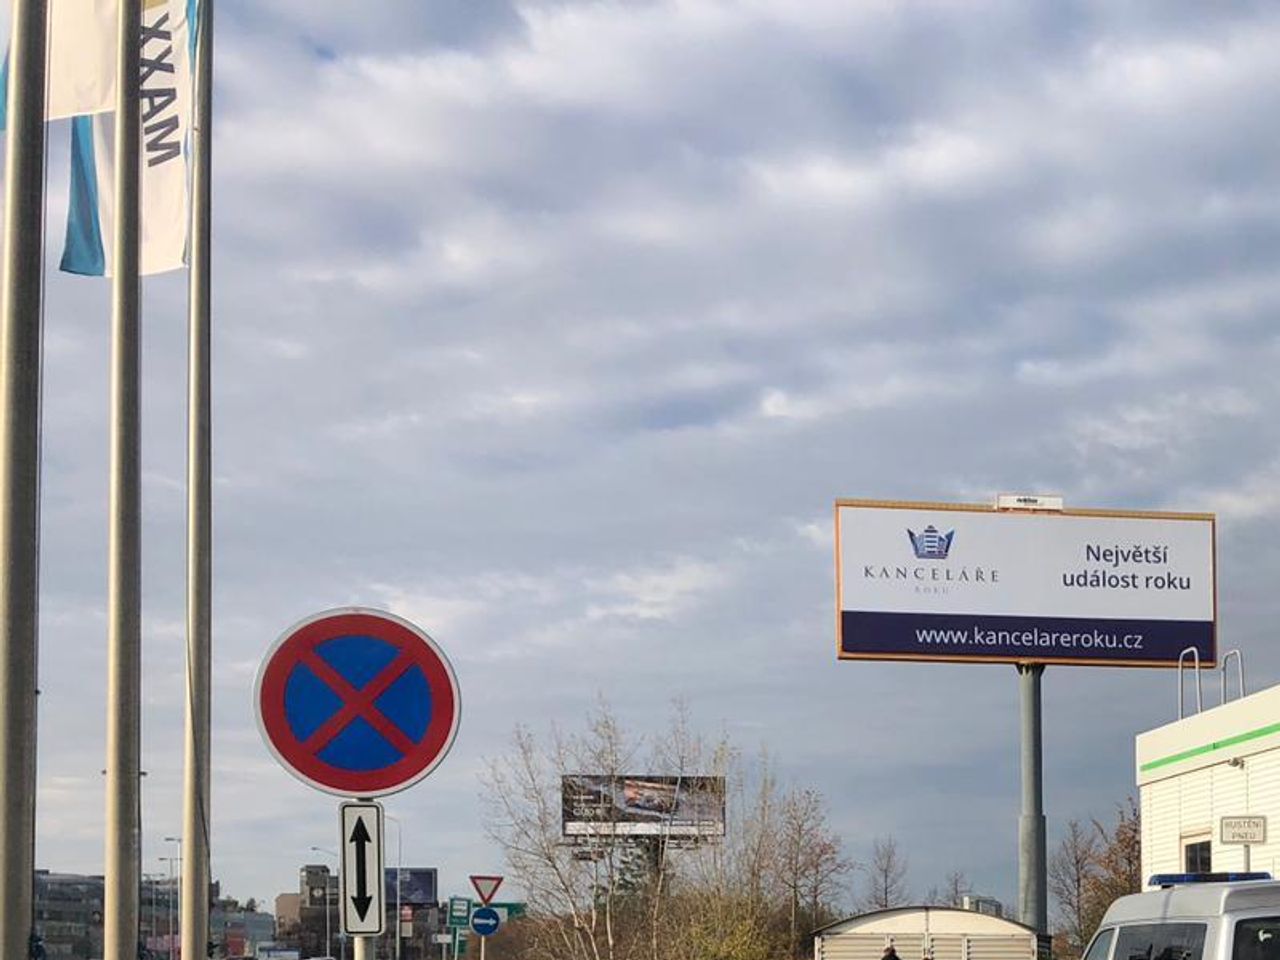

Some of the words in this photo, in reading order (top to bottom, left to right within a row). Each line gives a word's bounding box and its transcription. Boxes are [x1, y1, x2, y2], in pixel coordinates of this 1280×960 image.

[1085, 543, 1169, 568] Největší
[863, 564, 1000, 583] KANCELÁŘE
[1062, 569, 1139, 589] událost
[1145, 571, 1191, 590] roku
[915, 625, 1144, 649] www.kancelareroku.cz
